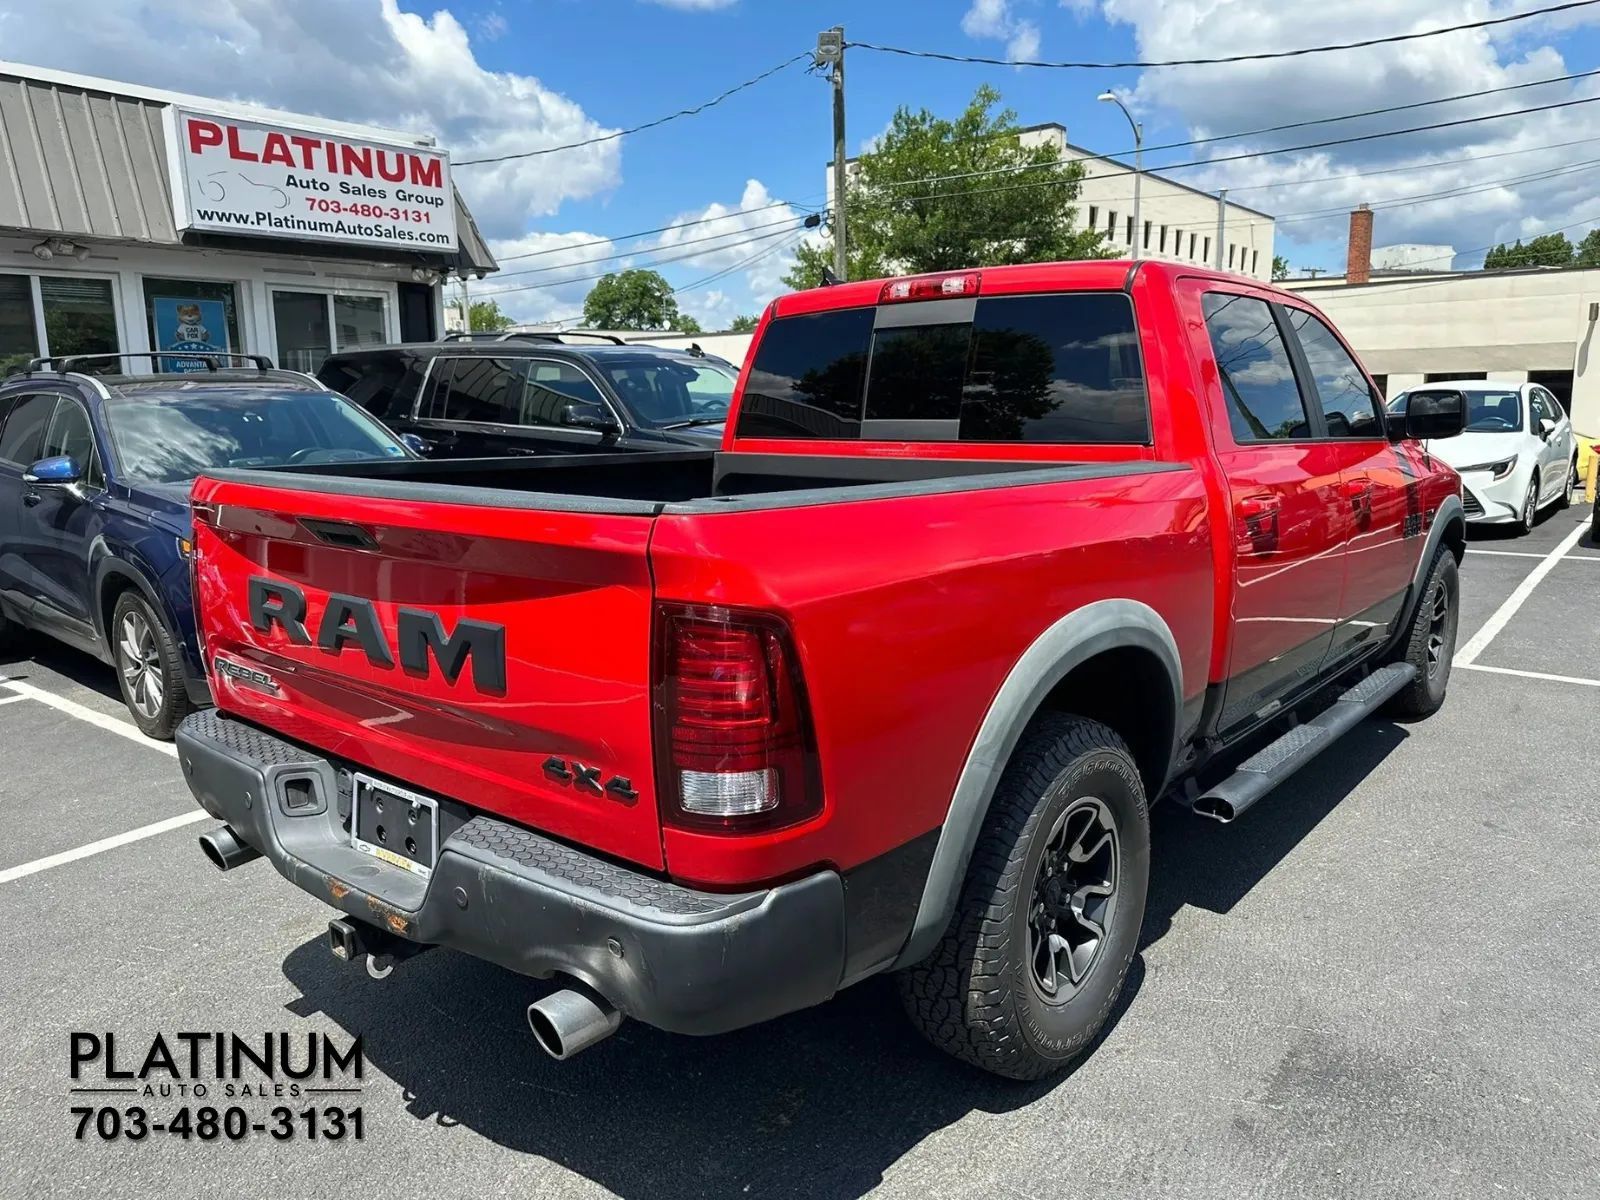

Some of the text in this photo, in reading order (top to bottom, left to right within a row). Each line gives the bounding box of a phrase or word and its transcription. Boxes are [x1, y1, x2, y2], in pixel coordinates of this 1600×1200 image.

[188, 119, 444, 188] PLATINUM
[286, 174, 444, 207] Auto Sales Group
[196, 208, 450, 245] www.PlatinumAutoSales.com
[305, 197, 431, 224] 703-480-3131
[248, 574, 507, 699] RAM
[213, 655, 281, 691] REBEL
